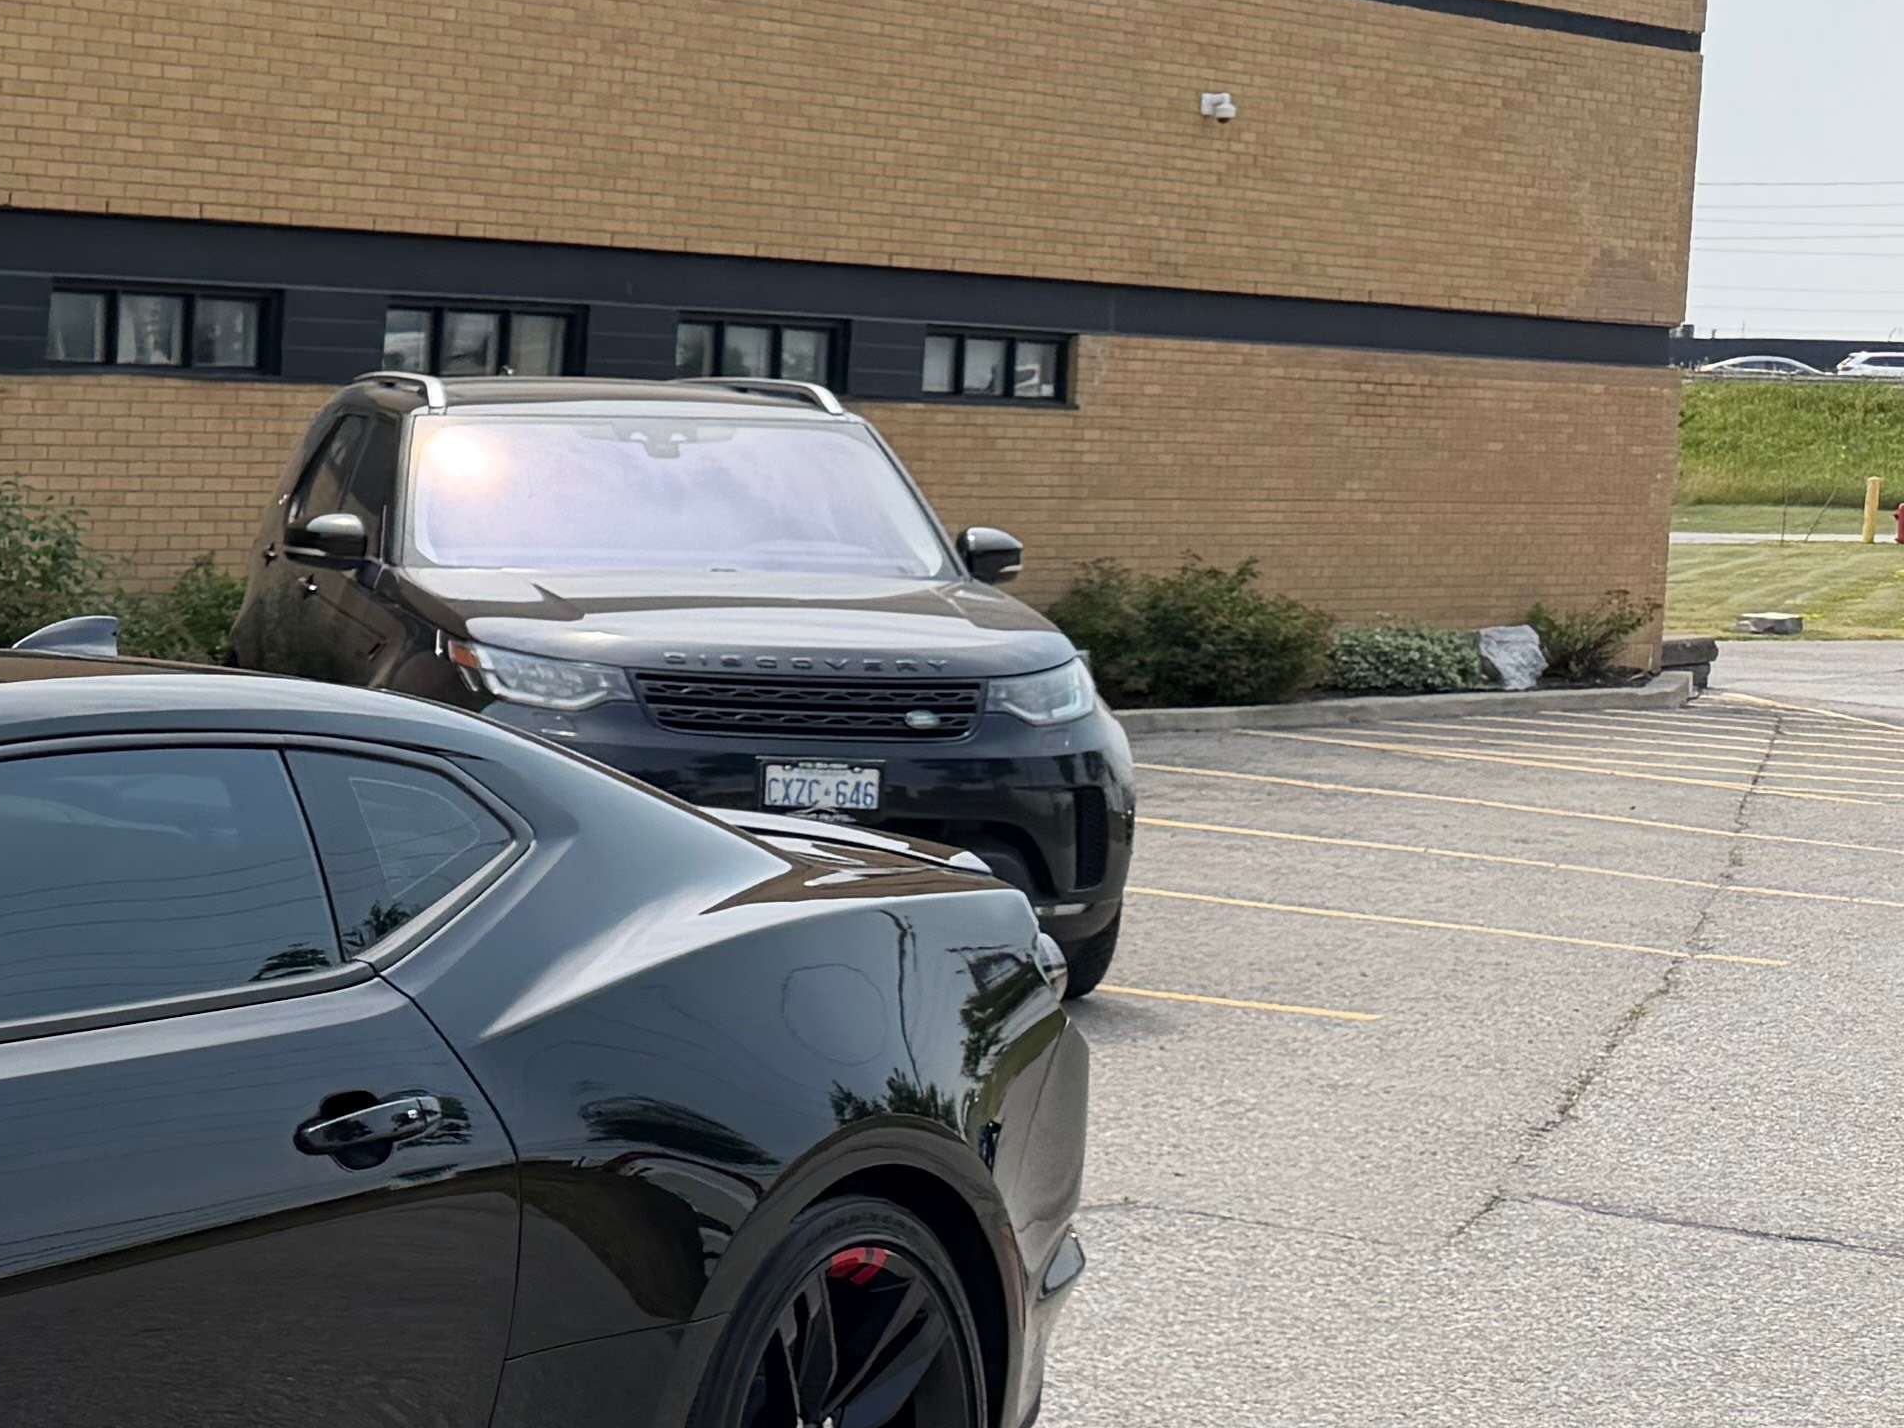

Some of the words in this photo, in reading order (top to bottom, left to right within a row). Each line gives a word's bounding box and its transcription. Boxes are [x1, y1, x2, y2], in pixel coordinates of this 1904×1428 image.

[662, 651, 949, 673] DISCOVERY
[767, 777, 822, 806] CXZC
[835, 780, 875, 810] 646
